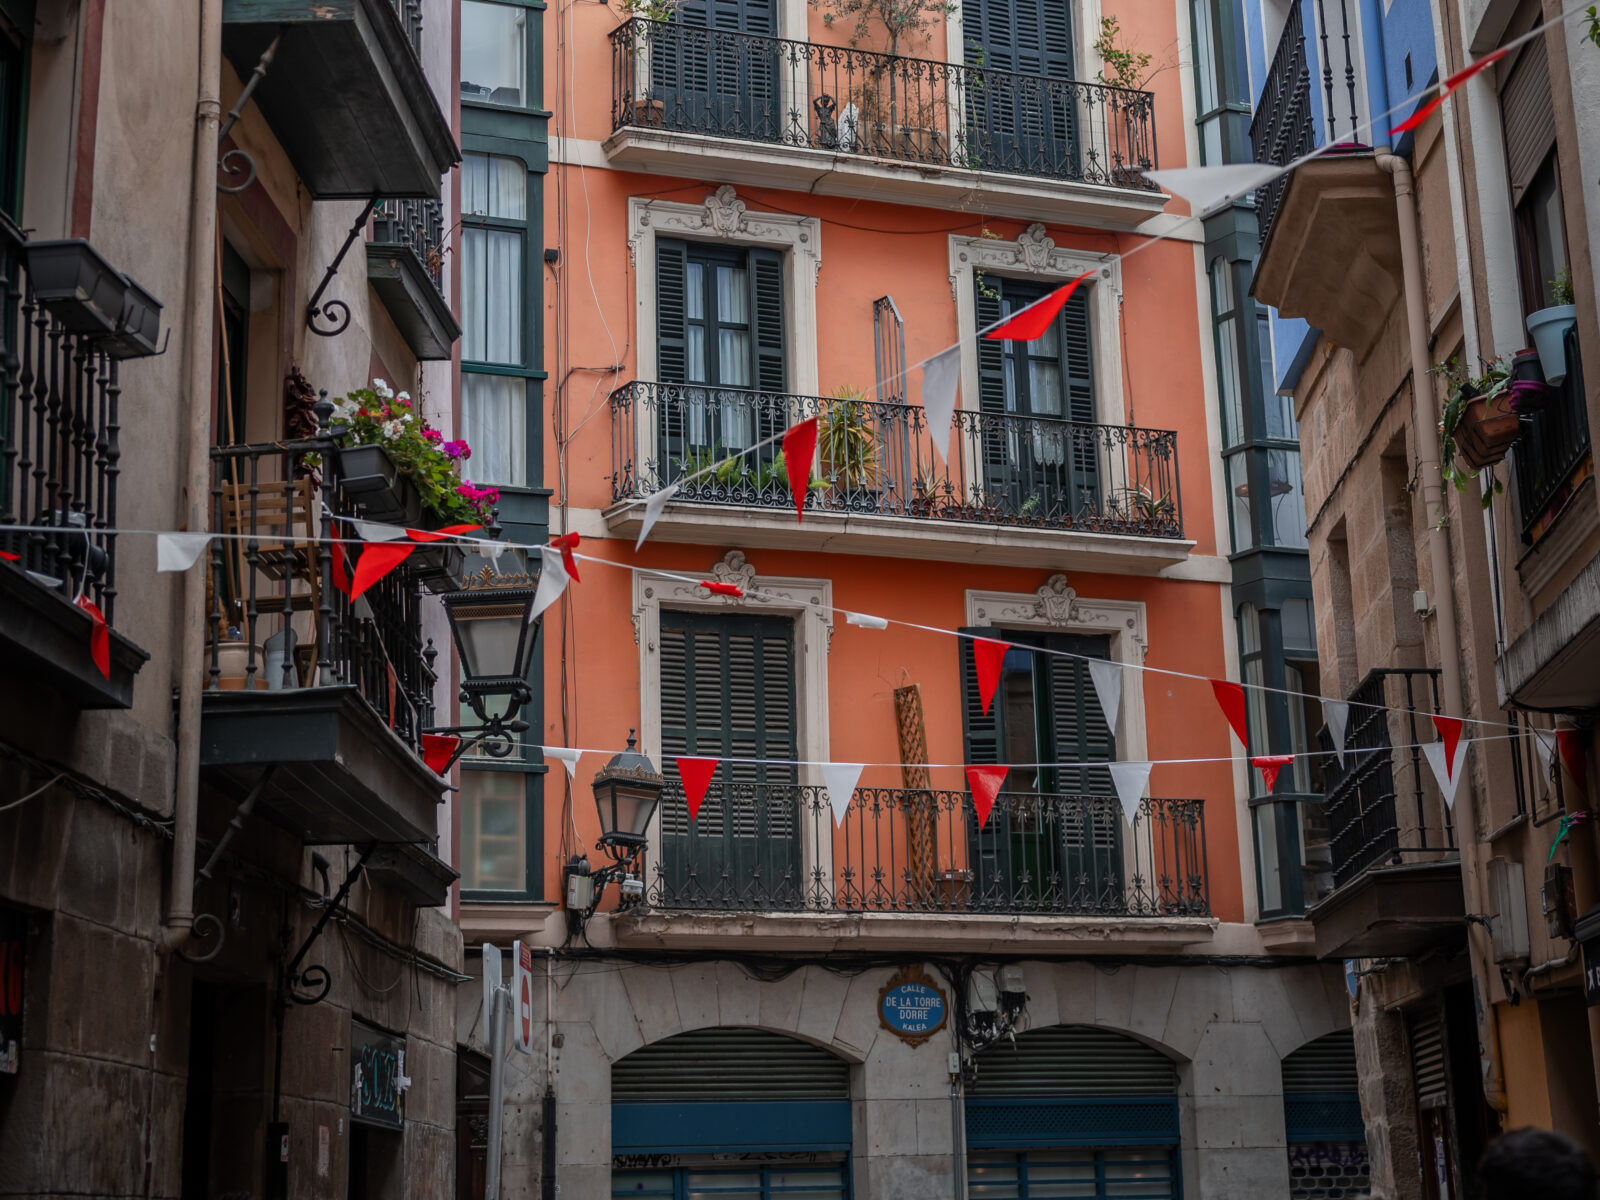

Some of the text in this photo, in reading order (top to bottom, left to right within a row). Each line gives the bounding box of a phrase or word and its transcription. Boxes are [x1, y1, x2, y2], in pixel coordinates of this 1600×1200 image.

[901, 985, 926, 993] CALLE
[886, 996, 941, 1008] DE LA TORRE
[900, 1010, 928, 1020] DORRE
[902, 1023, 927, 1031] KALEA
